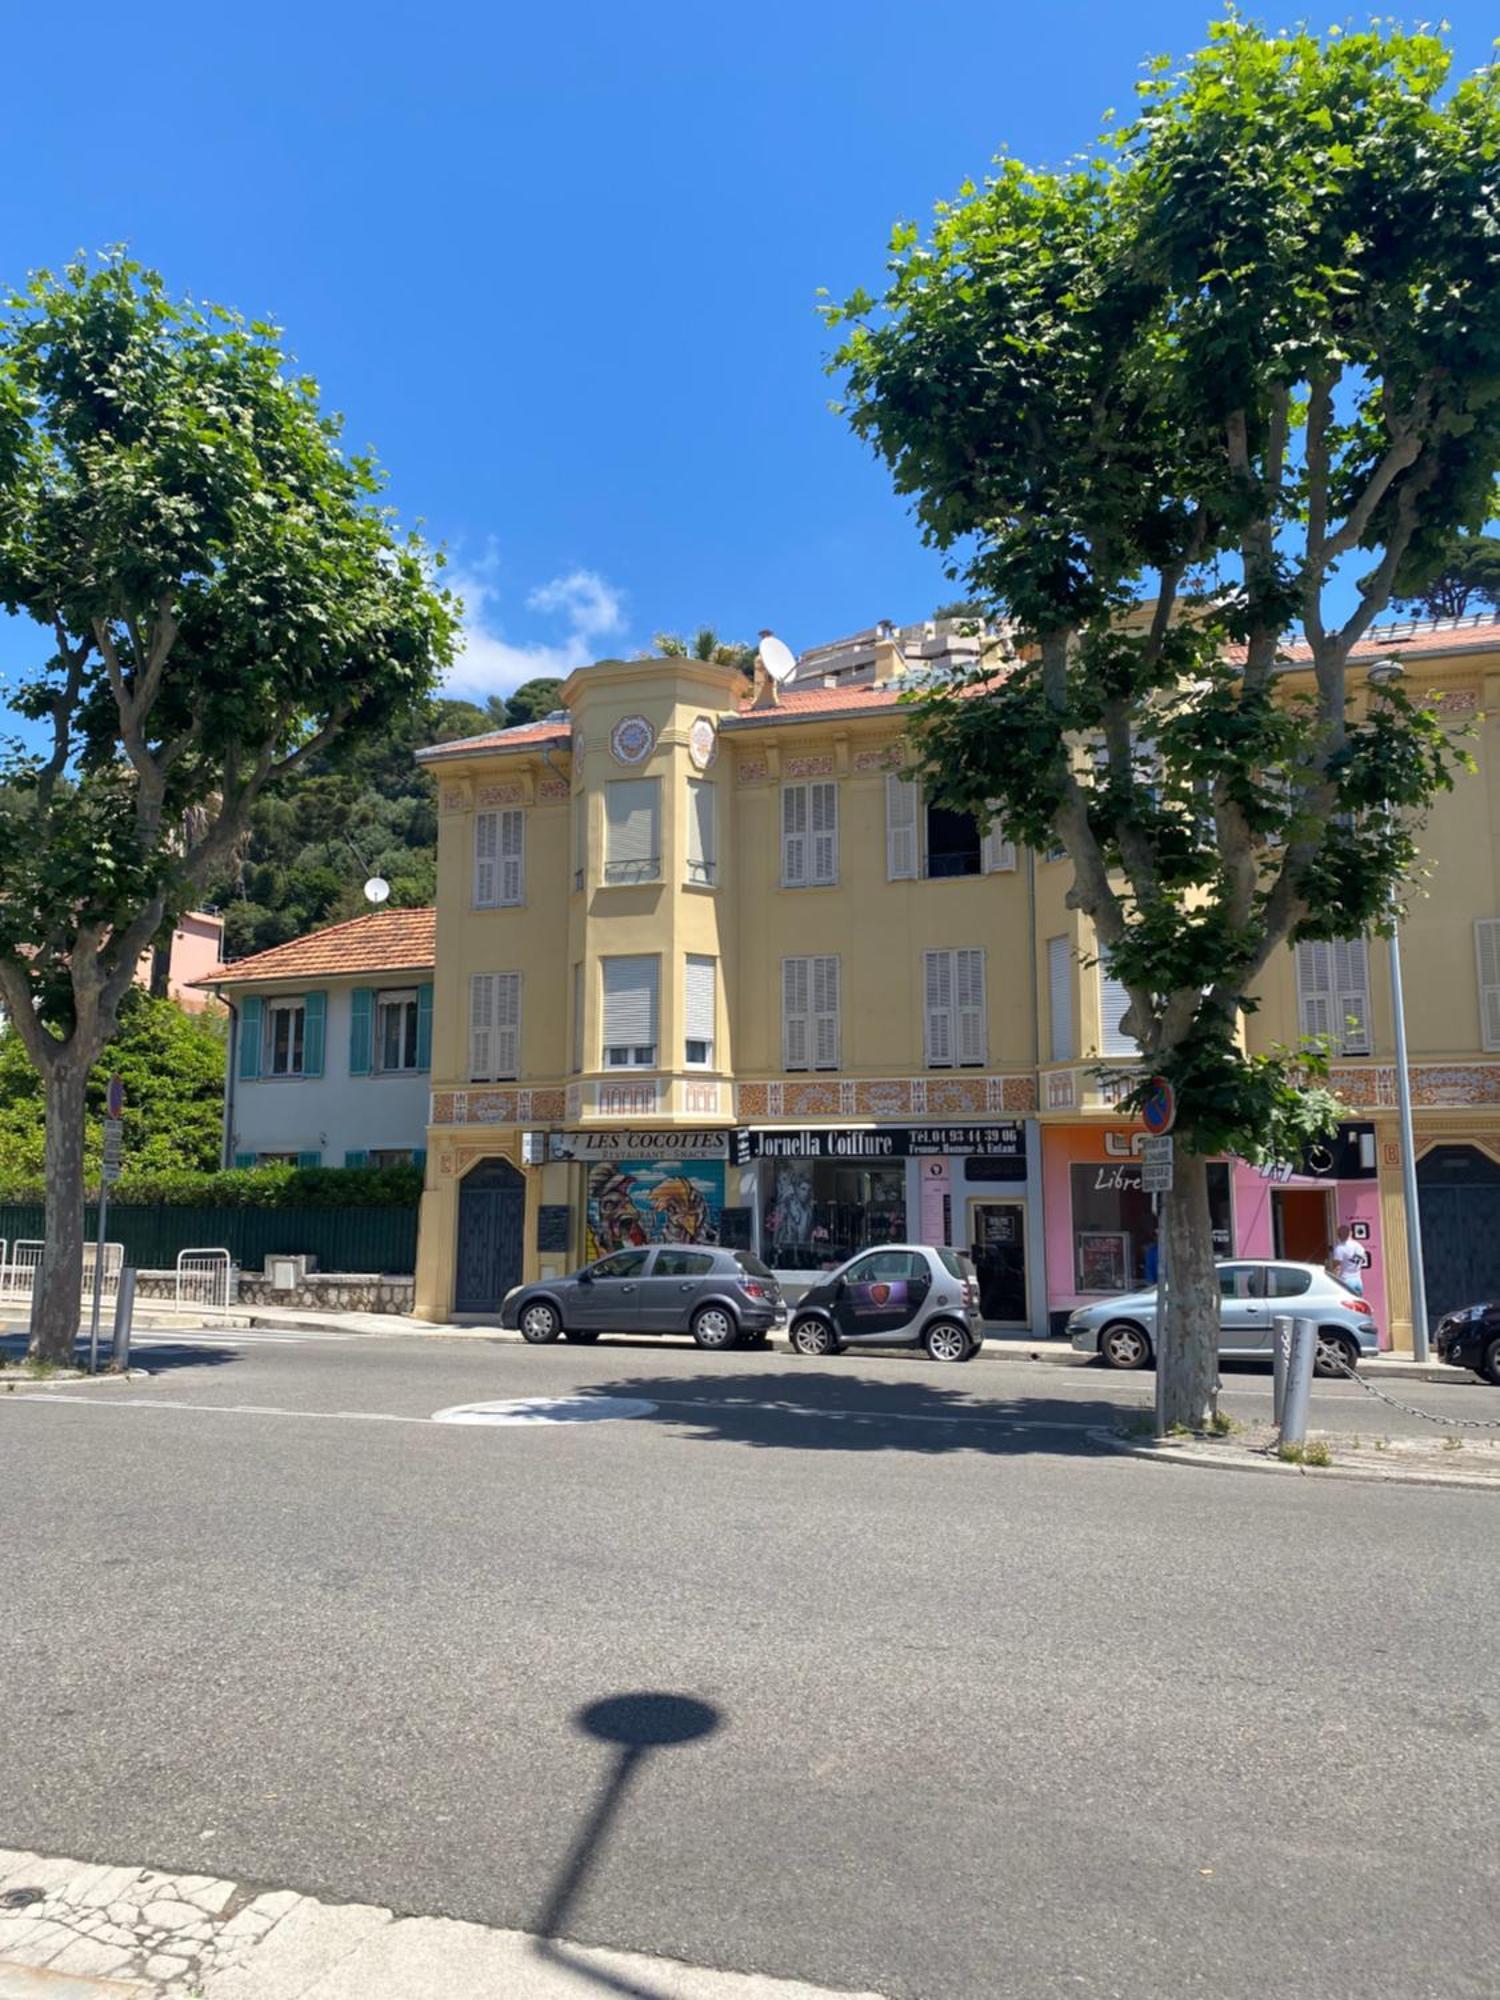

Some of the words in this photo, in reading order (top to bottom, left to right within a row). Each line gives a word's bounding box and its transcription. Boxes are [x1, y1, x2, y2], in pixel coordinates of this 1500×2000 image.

[586, 1133, 620, 1149] LES
[626, 1132, 726, 1149] COCOTTES
[754, 1131, 821, 1156] Jornella
[827, 1131, 893, 1155] Coiffure
[1094, 1164, 1142, 1191] Libre
